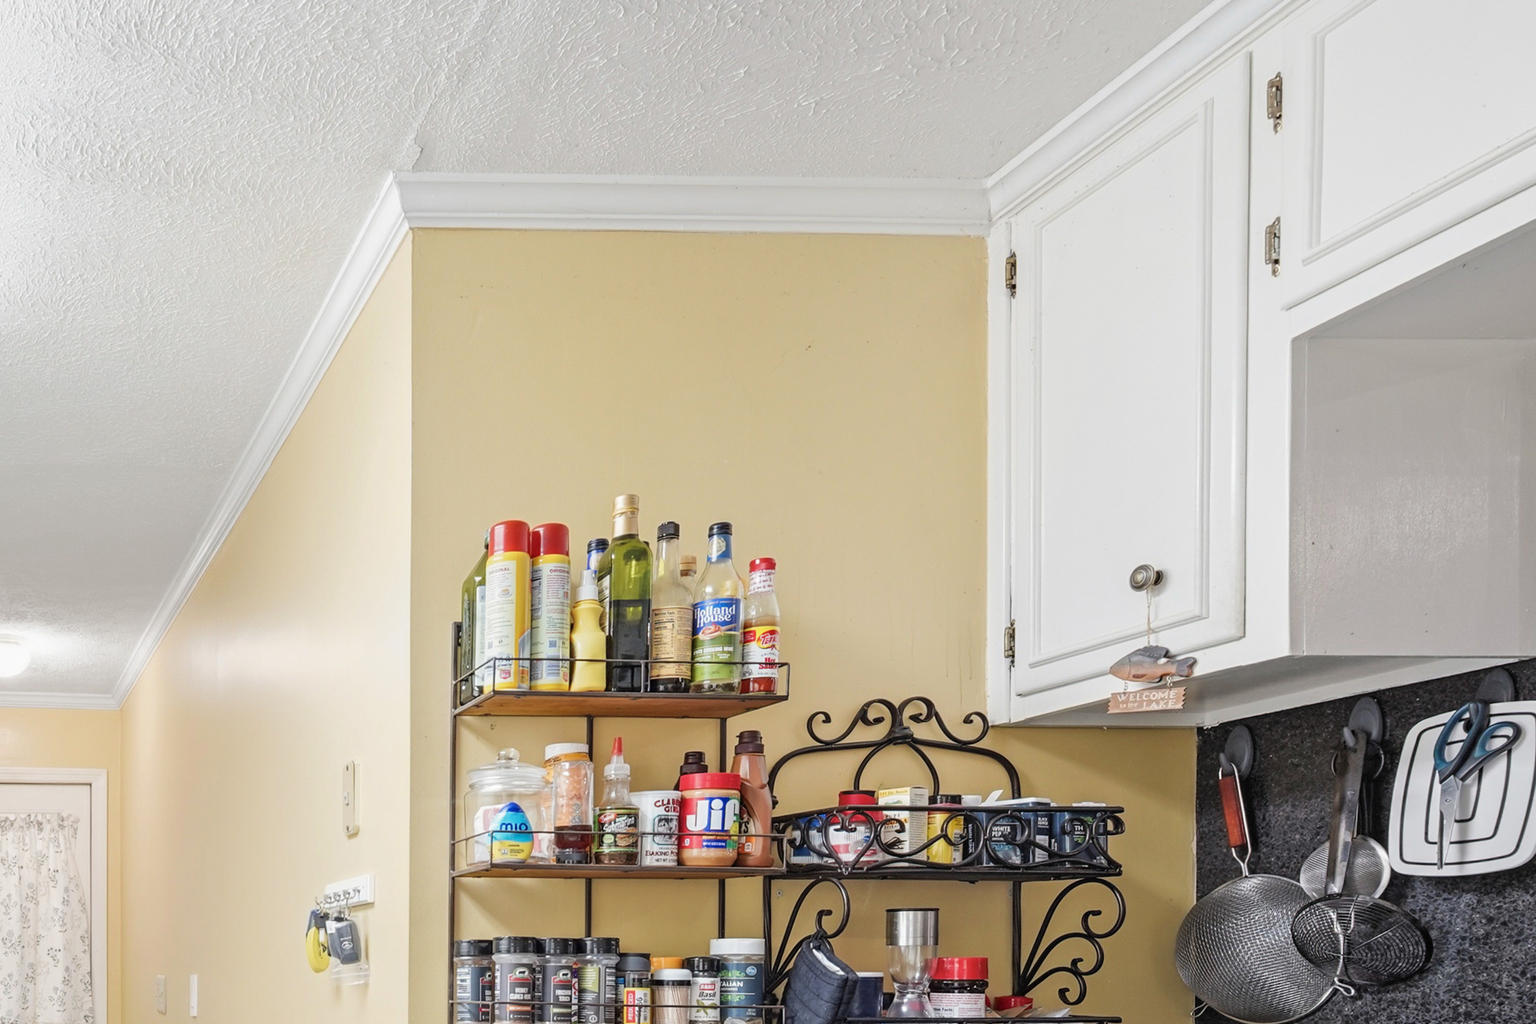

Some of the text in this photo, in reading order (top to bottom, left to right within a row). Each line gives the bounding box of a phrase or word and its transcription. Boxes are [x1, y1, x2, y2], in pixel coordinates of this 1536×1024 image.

[694, 604, 736, 620] Holland
[696, 612, 732, 628] House
[1117, 690, 1178, 702] WELCOME
[1143, 699, 1176, 709] LAKE
[654, 798, 681, 808] CLABB
[686, 799, 740, 831] Jif
[500, 822, 529, 831] mio
